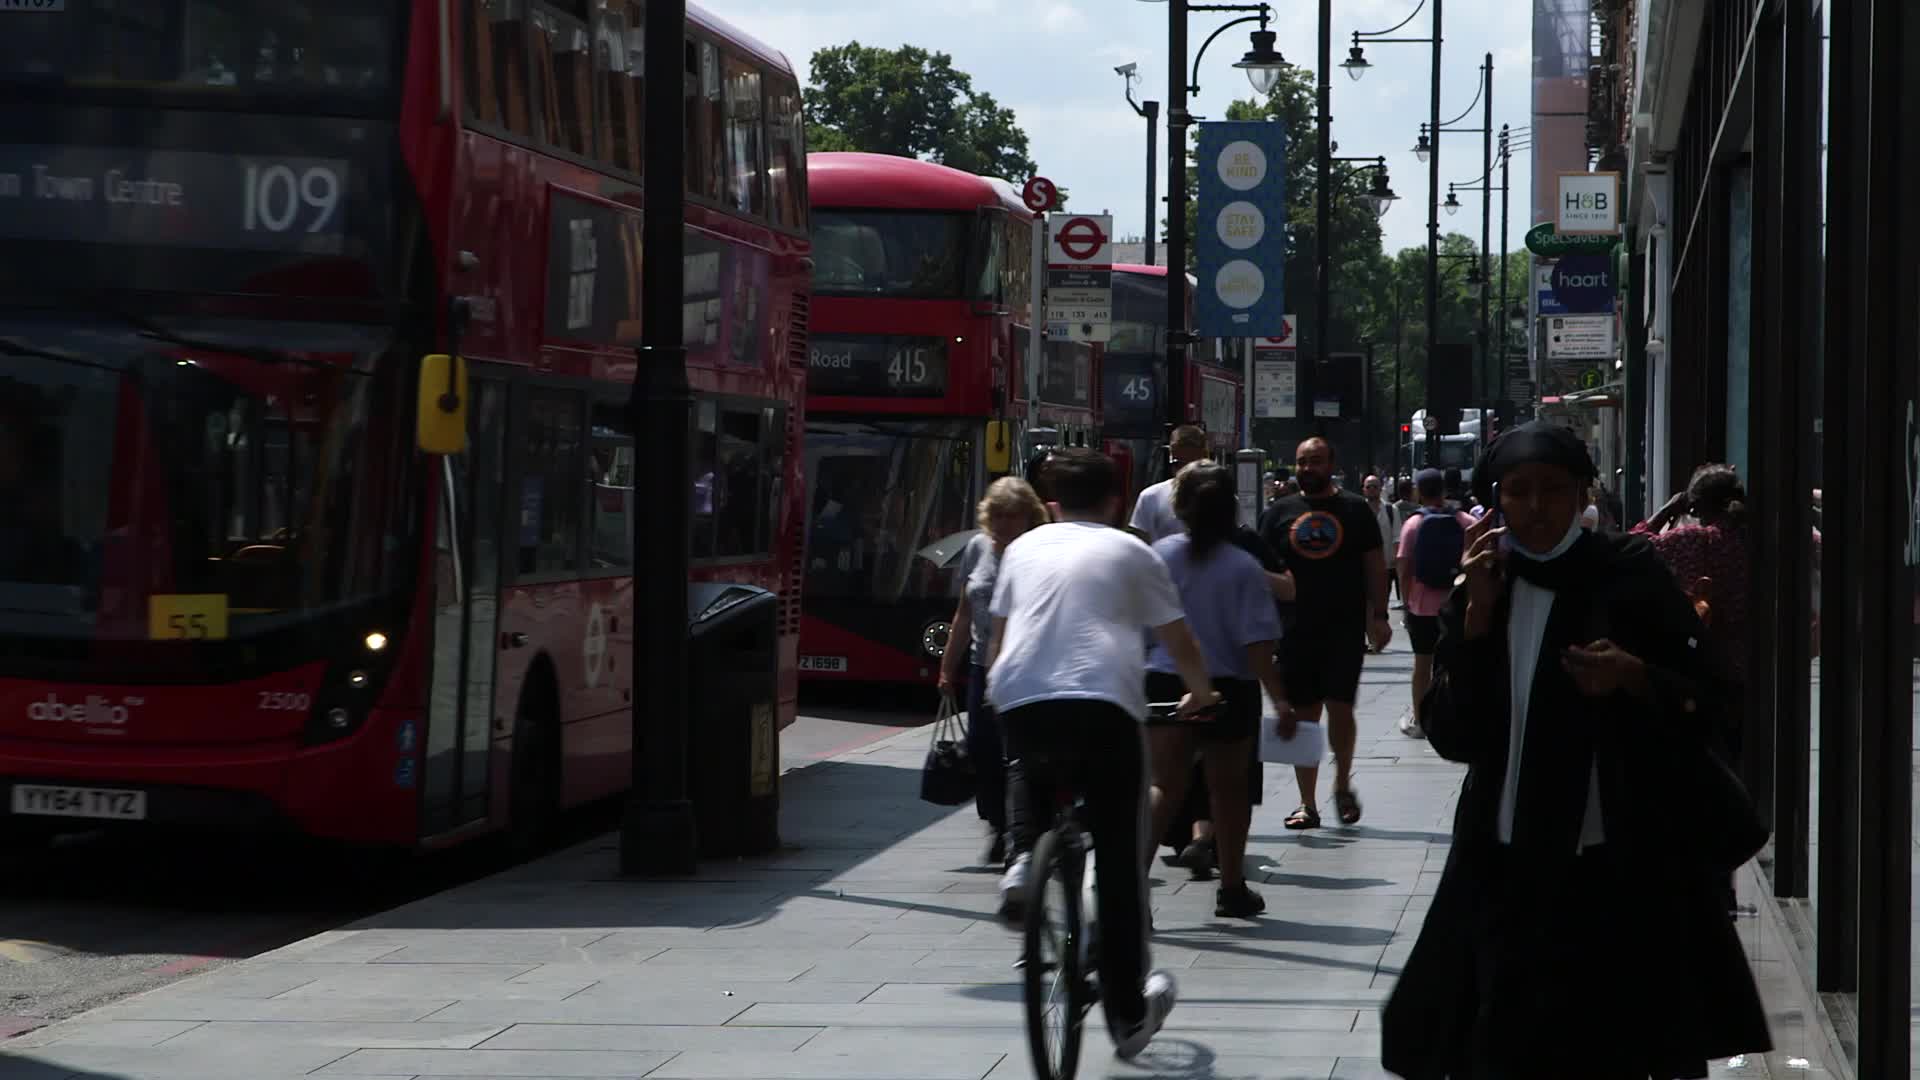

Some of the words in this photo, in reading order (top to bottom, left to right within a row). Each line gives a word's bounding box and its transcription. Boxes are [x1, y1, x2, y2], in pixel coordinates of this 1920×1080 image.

[32, 163, 94, 200] Town
[104, 168, 183, 206] Centre
[1226, 166, 1257, 177] KIND
[242, 163, 340, 233] 109
[1032, 181, 1047, 207] S
[1566, 192, 1608, 210] H&B
[1559, 271, 1608, 287] haart
[809, 350, 851, 369] Road
[887, 349, 928, 384] 415
[1122, 377, 1151, 401] 45
[167, 614, 208, 640] 55
[27, 693, 129, 725] abellio
[257, 690, 312, 712] 2500
